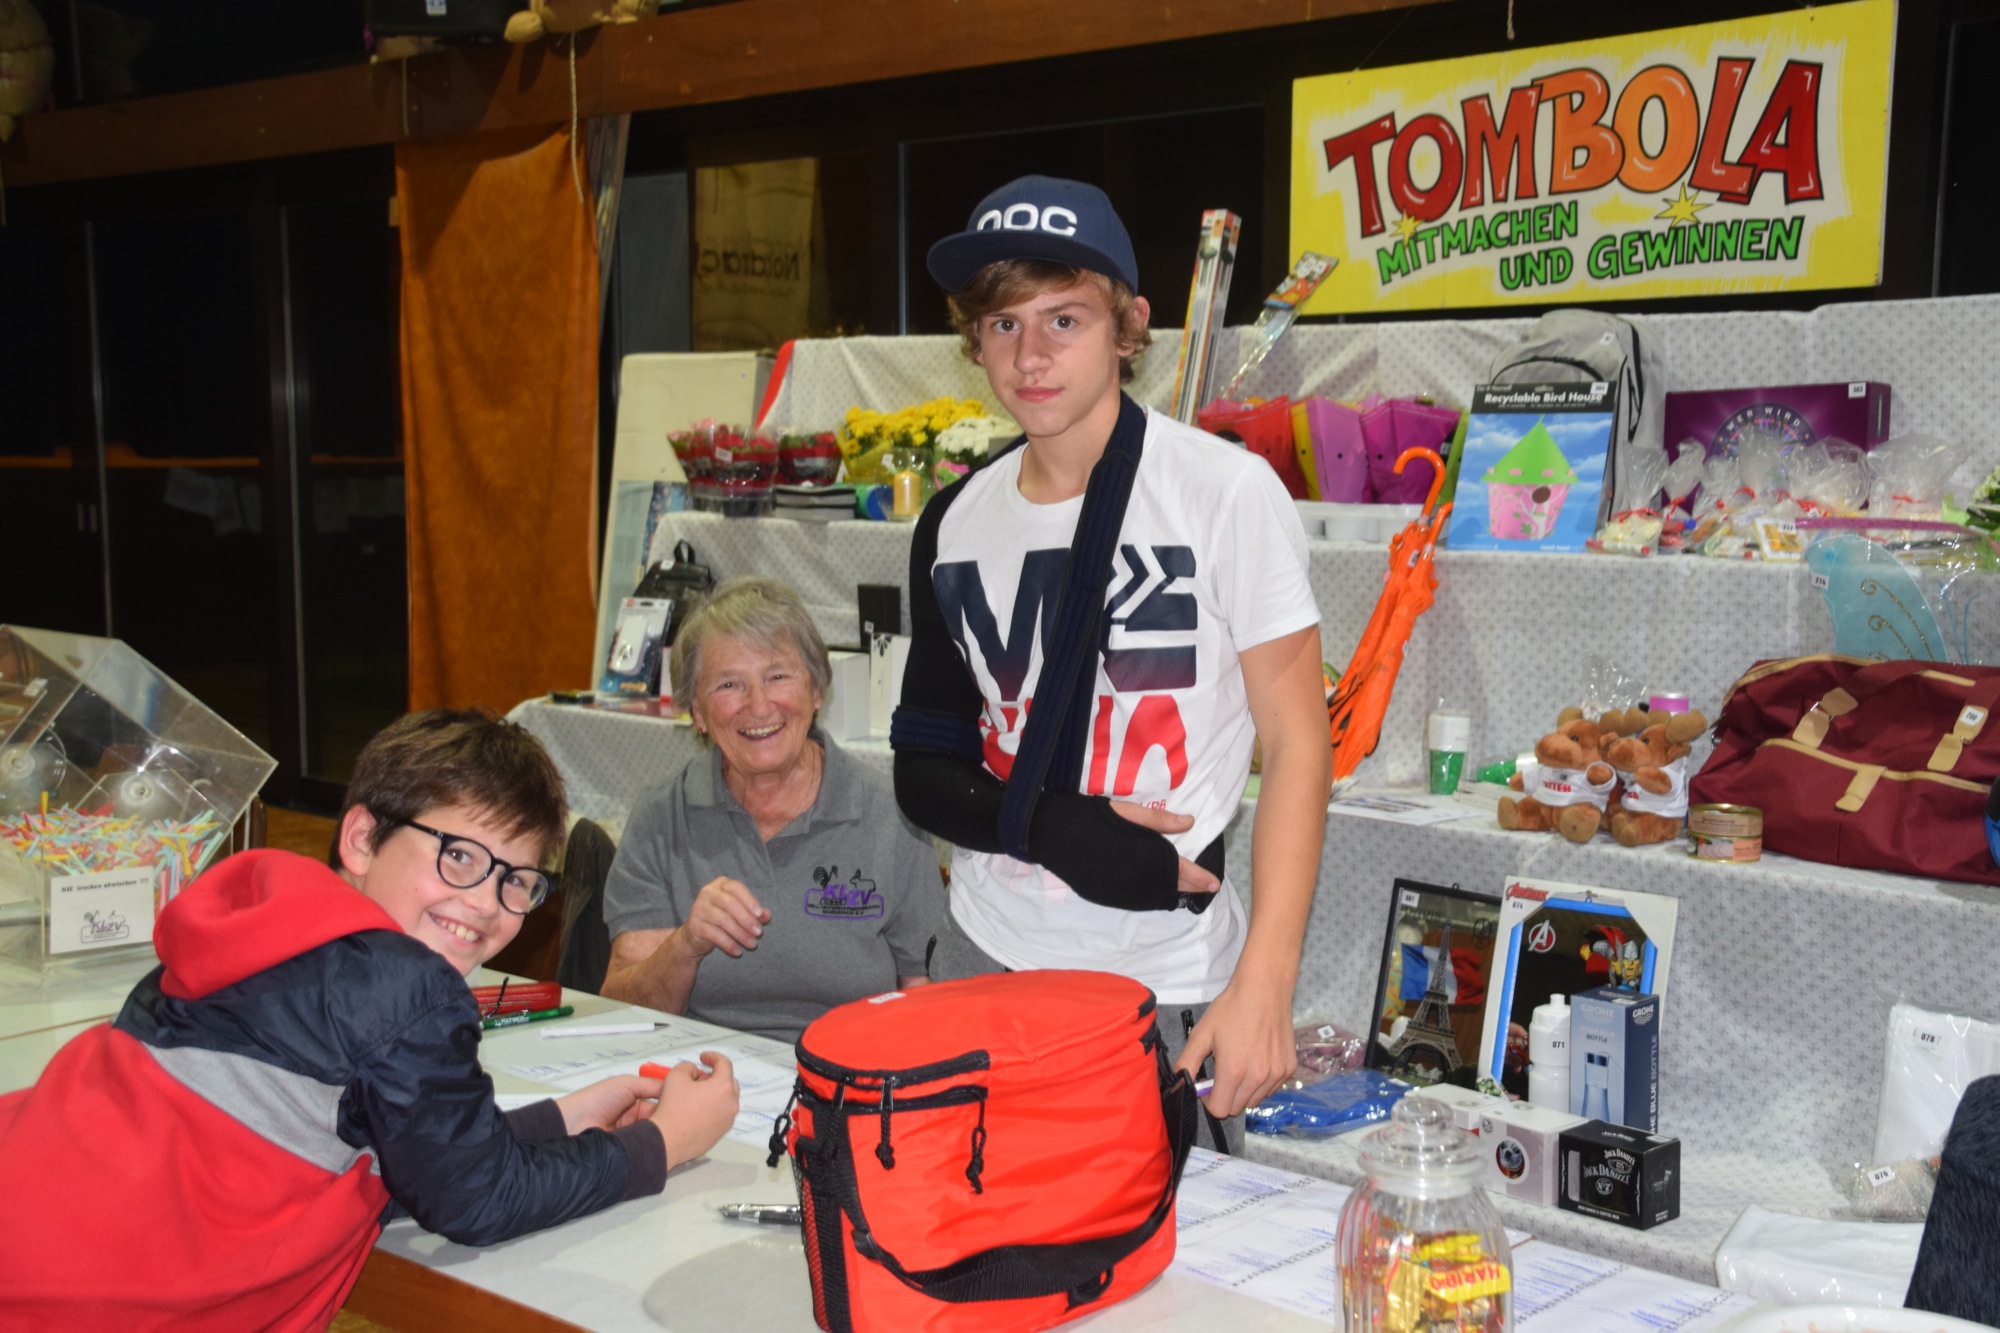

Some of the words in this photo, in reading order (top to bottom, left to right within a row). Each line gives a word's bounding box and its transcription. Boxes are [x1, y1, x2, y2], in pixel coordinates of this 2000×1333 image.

[1324, 57, 1824, 239] TOMBOLA
[1377, 201, 1578, 285] MITMACHEN
[1500, 247, 1574, 291] UND
[1588, 216, 1805, 280] GEWINNEN
[1484, 392, 1541, 405] Recyclable
[1543, 391, 1566, 403] Bird
[1568, 392, 1604, 403] House
[1727, 409, 1754, 431] WER
[1764, 406, 1801, 427] WIRD
[104, 879, 137, 889] abwischen
[1580, 1003, 1615, 1018] GROHE
[1632, 1004, 1655, 1018] GROHE
[1586, 1033, 1608, 1043] BOTTLE
[1921, 1032, 1935, 1043] 078
[1552, 1041, 1565, 1049] 071
[1604, 1149, 1617, 1159] JACK
[1583, 1164, 1598, 1178] JACK
[1874, 1170, 1889, 1181] 076
[1430, 1262, 1501, 1291] HARIBO
